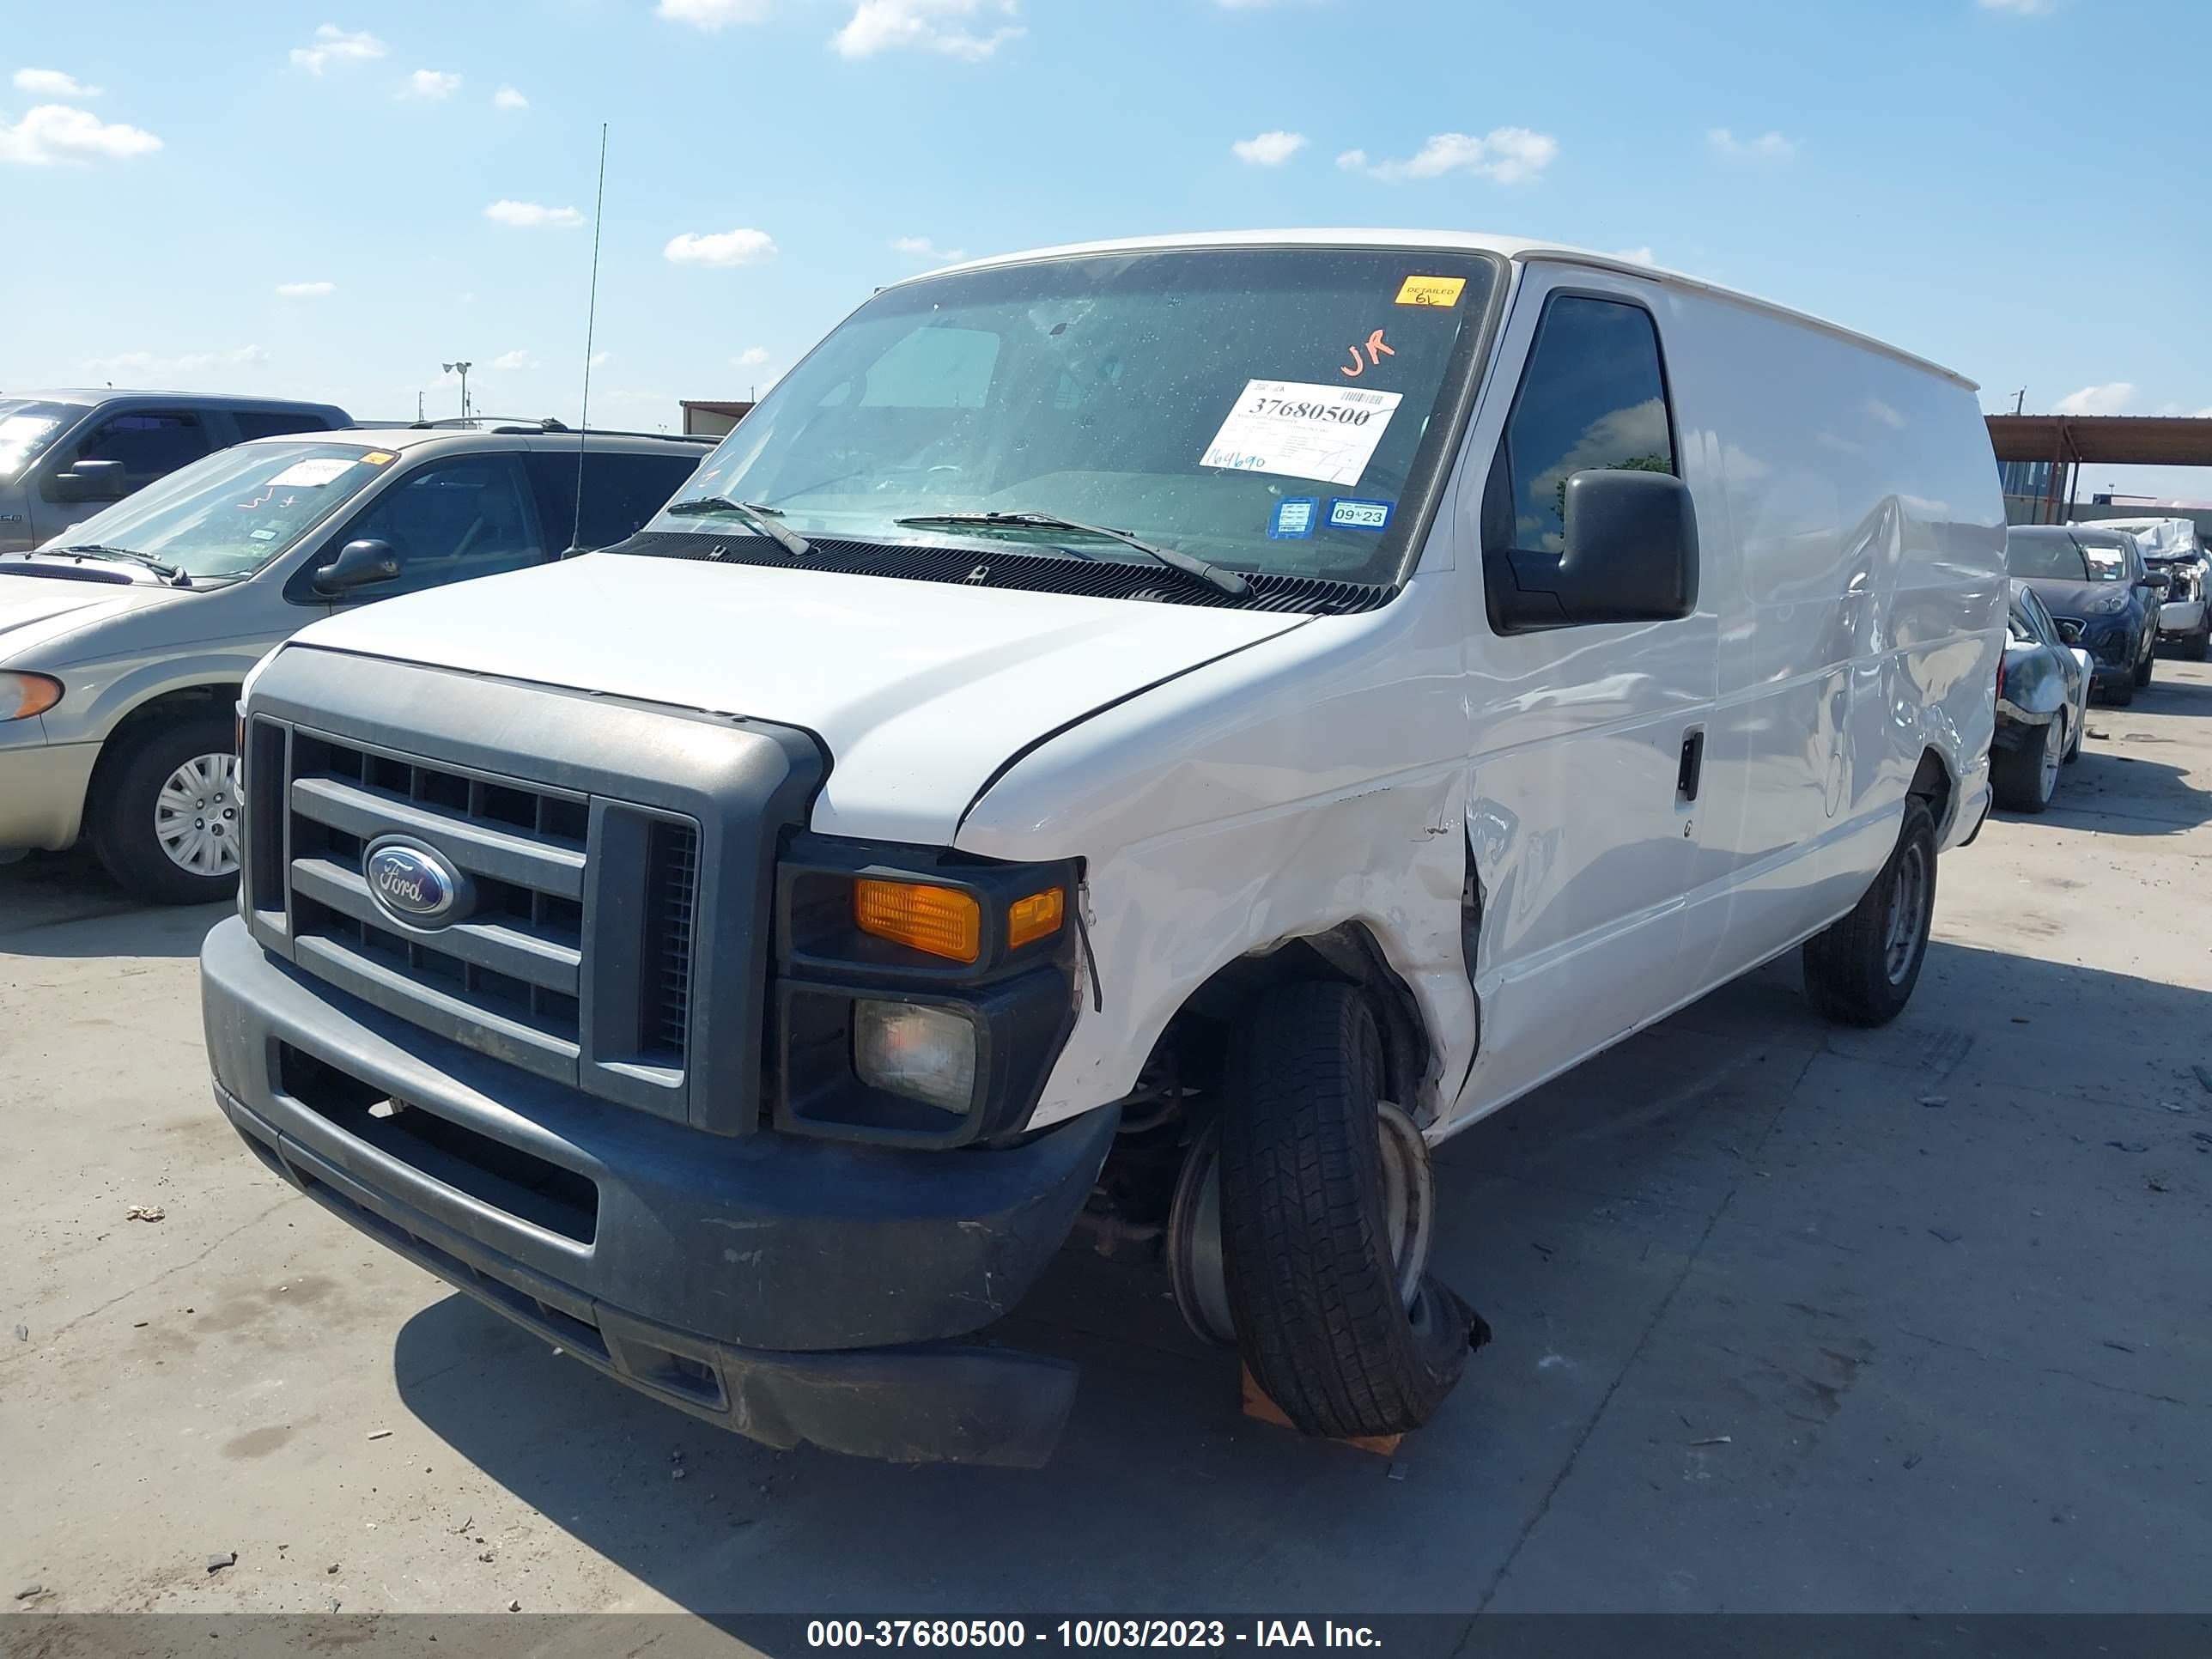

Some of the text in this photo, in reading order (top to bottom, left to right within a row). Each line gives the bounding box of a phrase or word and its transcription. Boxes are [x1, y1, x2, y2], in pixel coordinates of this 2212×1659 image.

[1340, 329, 1395, 377] JR
[1249, 398, 1371, 427] 37680500
[1206, 447, 1267, 471] 164690
[1335, 508, 1383, 523] 09 23
[380, 858, 423, 902] Ford
